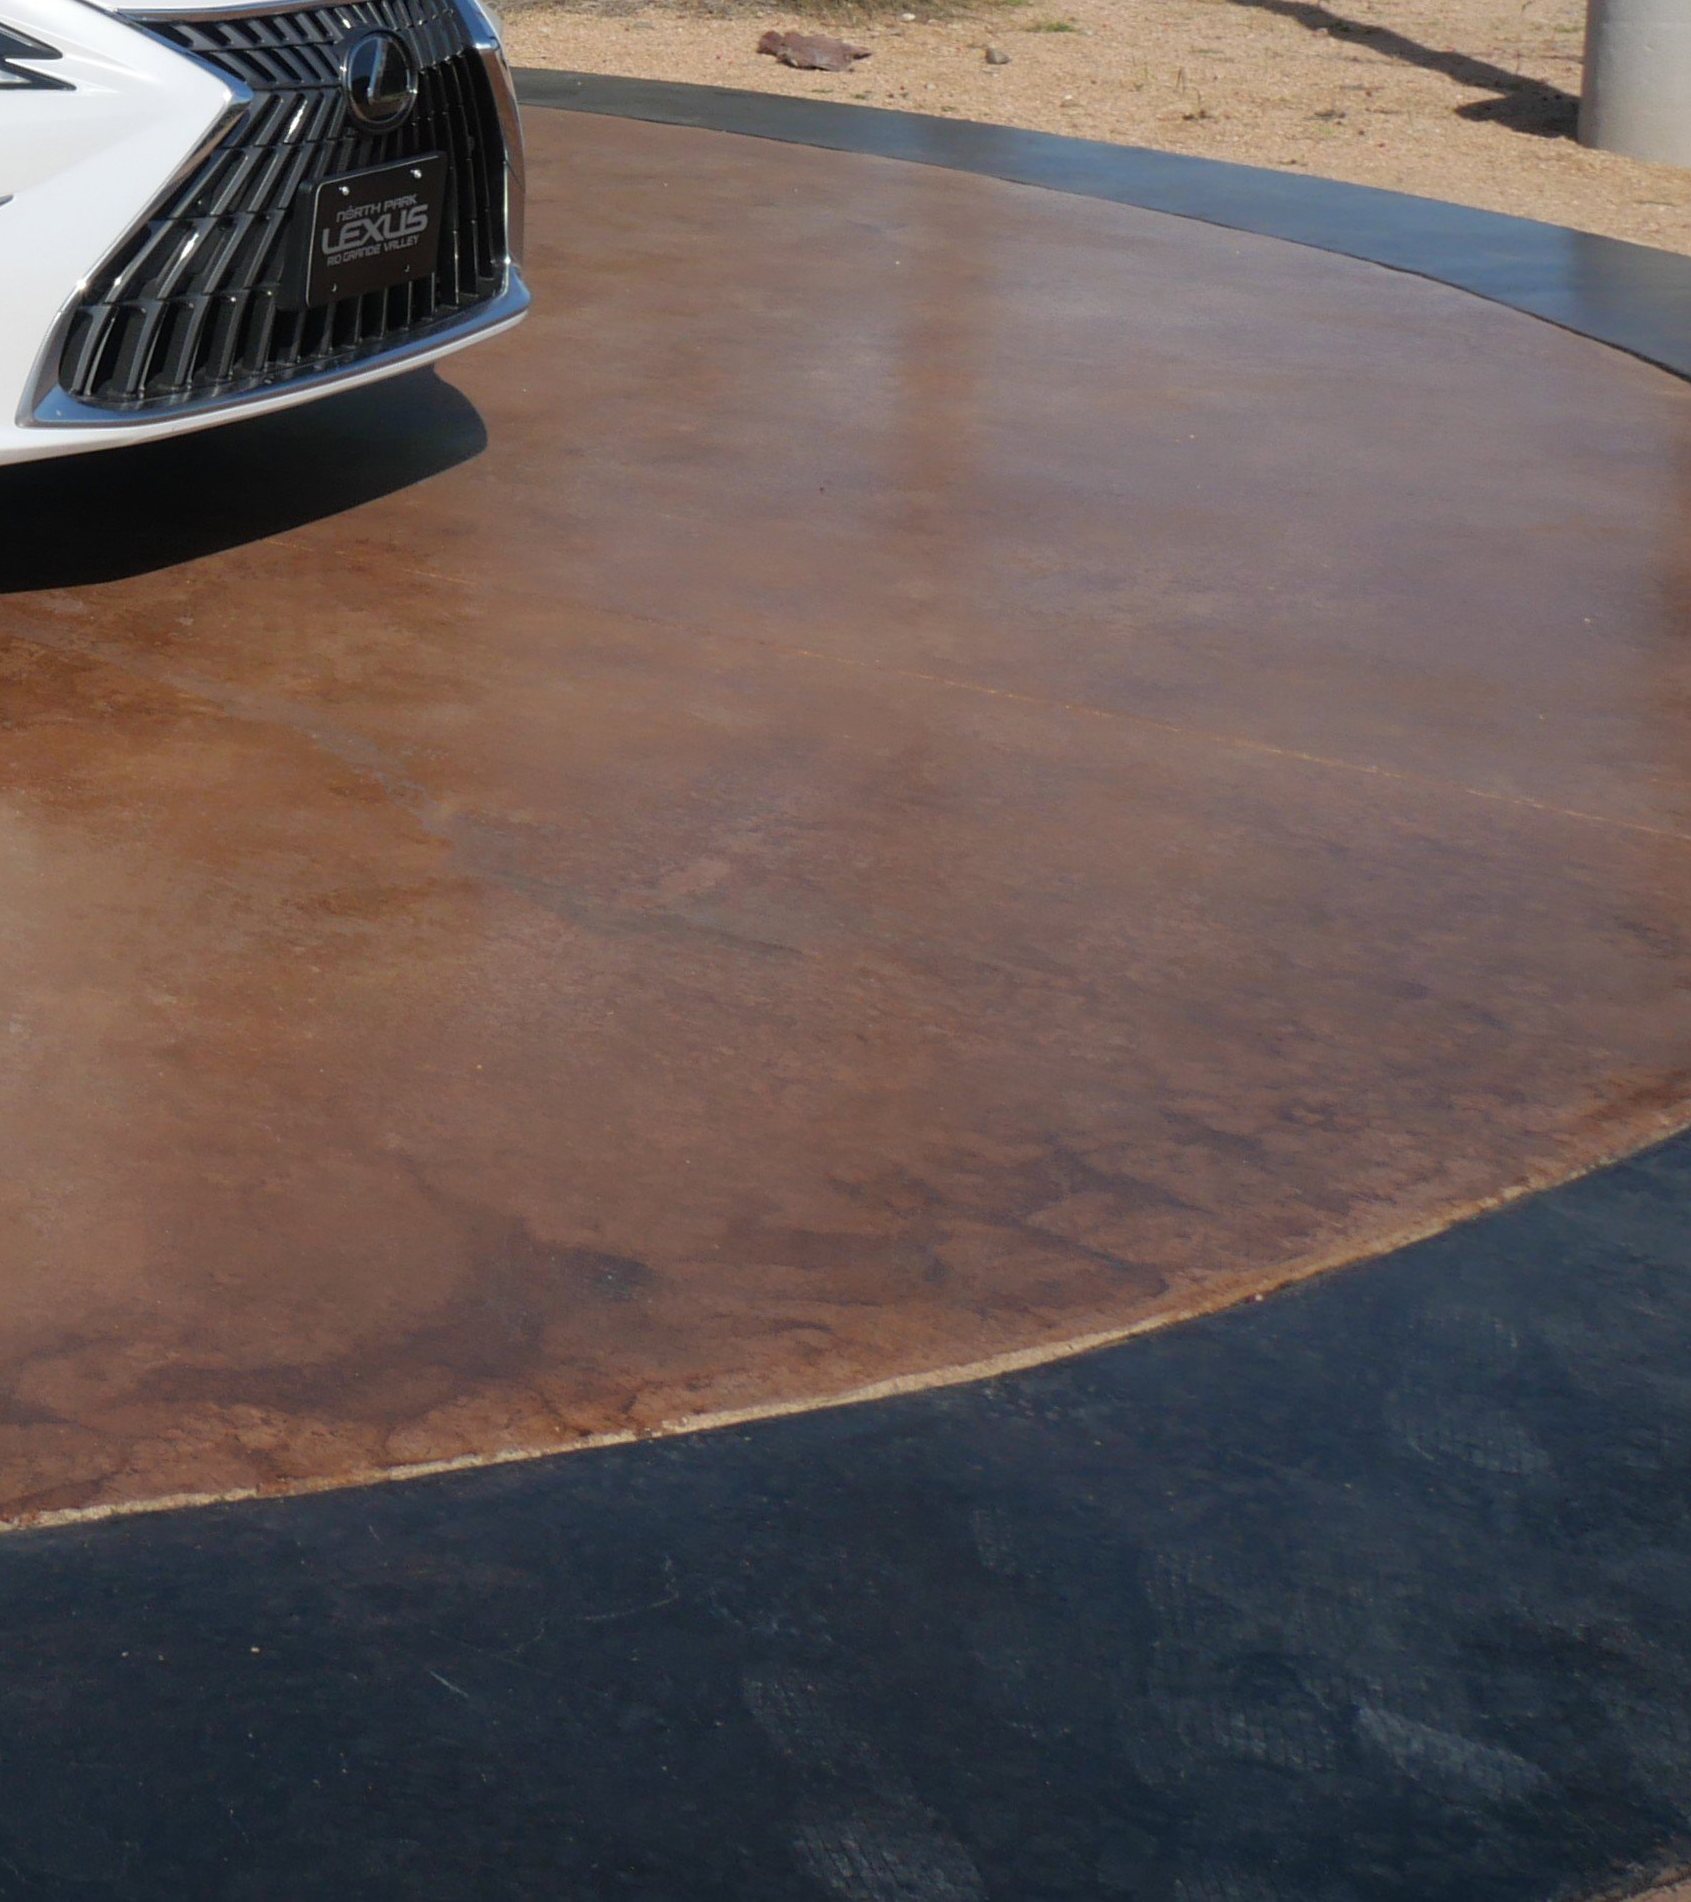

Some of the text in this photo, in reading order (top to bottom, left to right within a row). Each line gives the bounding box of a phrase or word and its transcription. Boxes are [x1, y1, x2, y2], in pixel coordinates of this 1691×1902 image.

[383, 194, 418, 212] PARK
[321, 204, 429, 255] LEXUS
[327, 235, 419, 267] RIO GRANDE VALLEY
